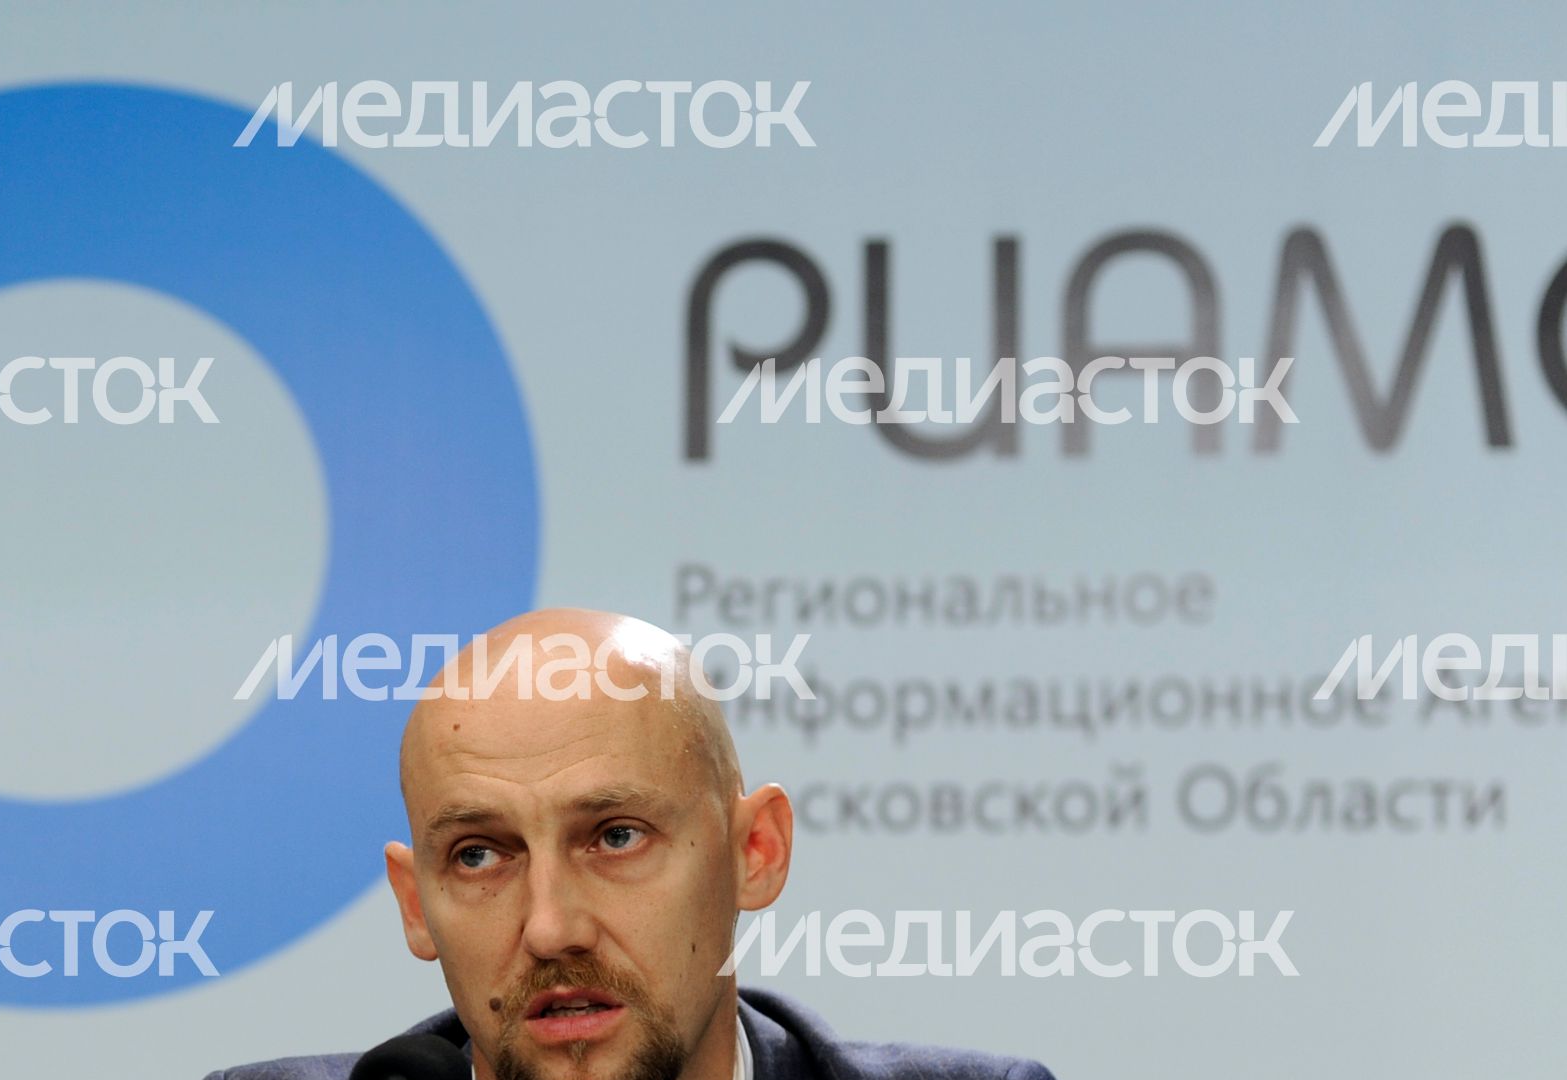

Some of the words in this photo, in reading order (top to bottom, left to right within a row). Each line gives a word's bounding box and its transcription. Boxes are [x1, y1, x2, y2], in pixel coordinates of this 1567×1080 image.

[682, 220, 1567, 464] РИАМ
[674, 562, 1217, 629] Региональное
[708, 662, 1389, 748] нформационное
[794, 762, 1150, 836] сковской
[1175, 761, 1509, 834] Области
